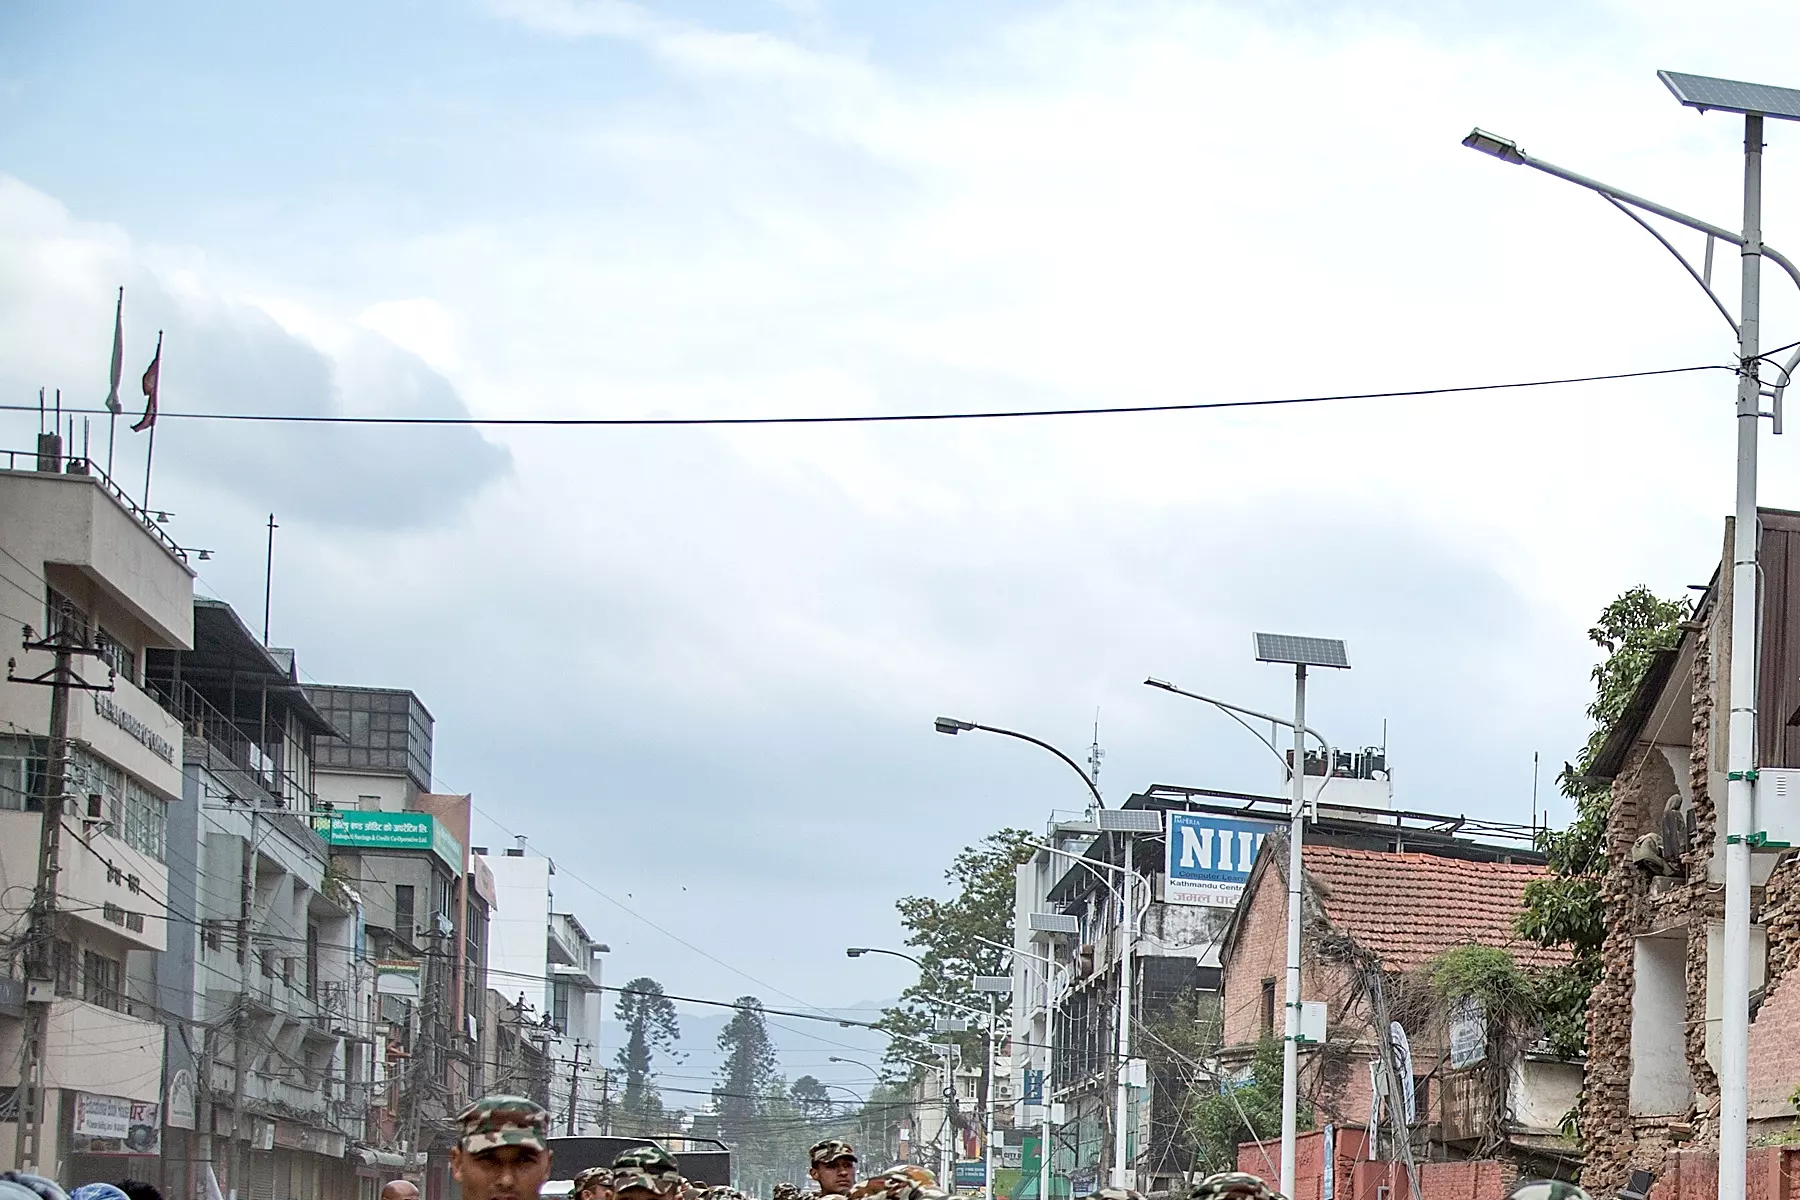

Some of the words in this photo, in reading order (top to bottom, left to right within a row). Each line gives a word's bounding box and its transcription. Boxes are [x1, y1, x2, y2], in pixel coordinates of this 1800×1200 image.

[1180, 826, 1265, 872] NII
[1179, 870, 1221, 881] Computer
[1170, 880, 1218, 889] Kathmandu
